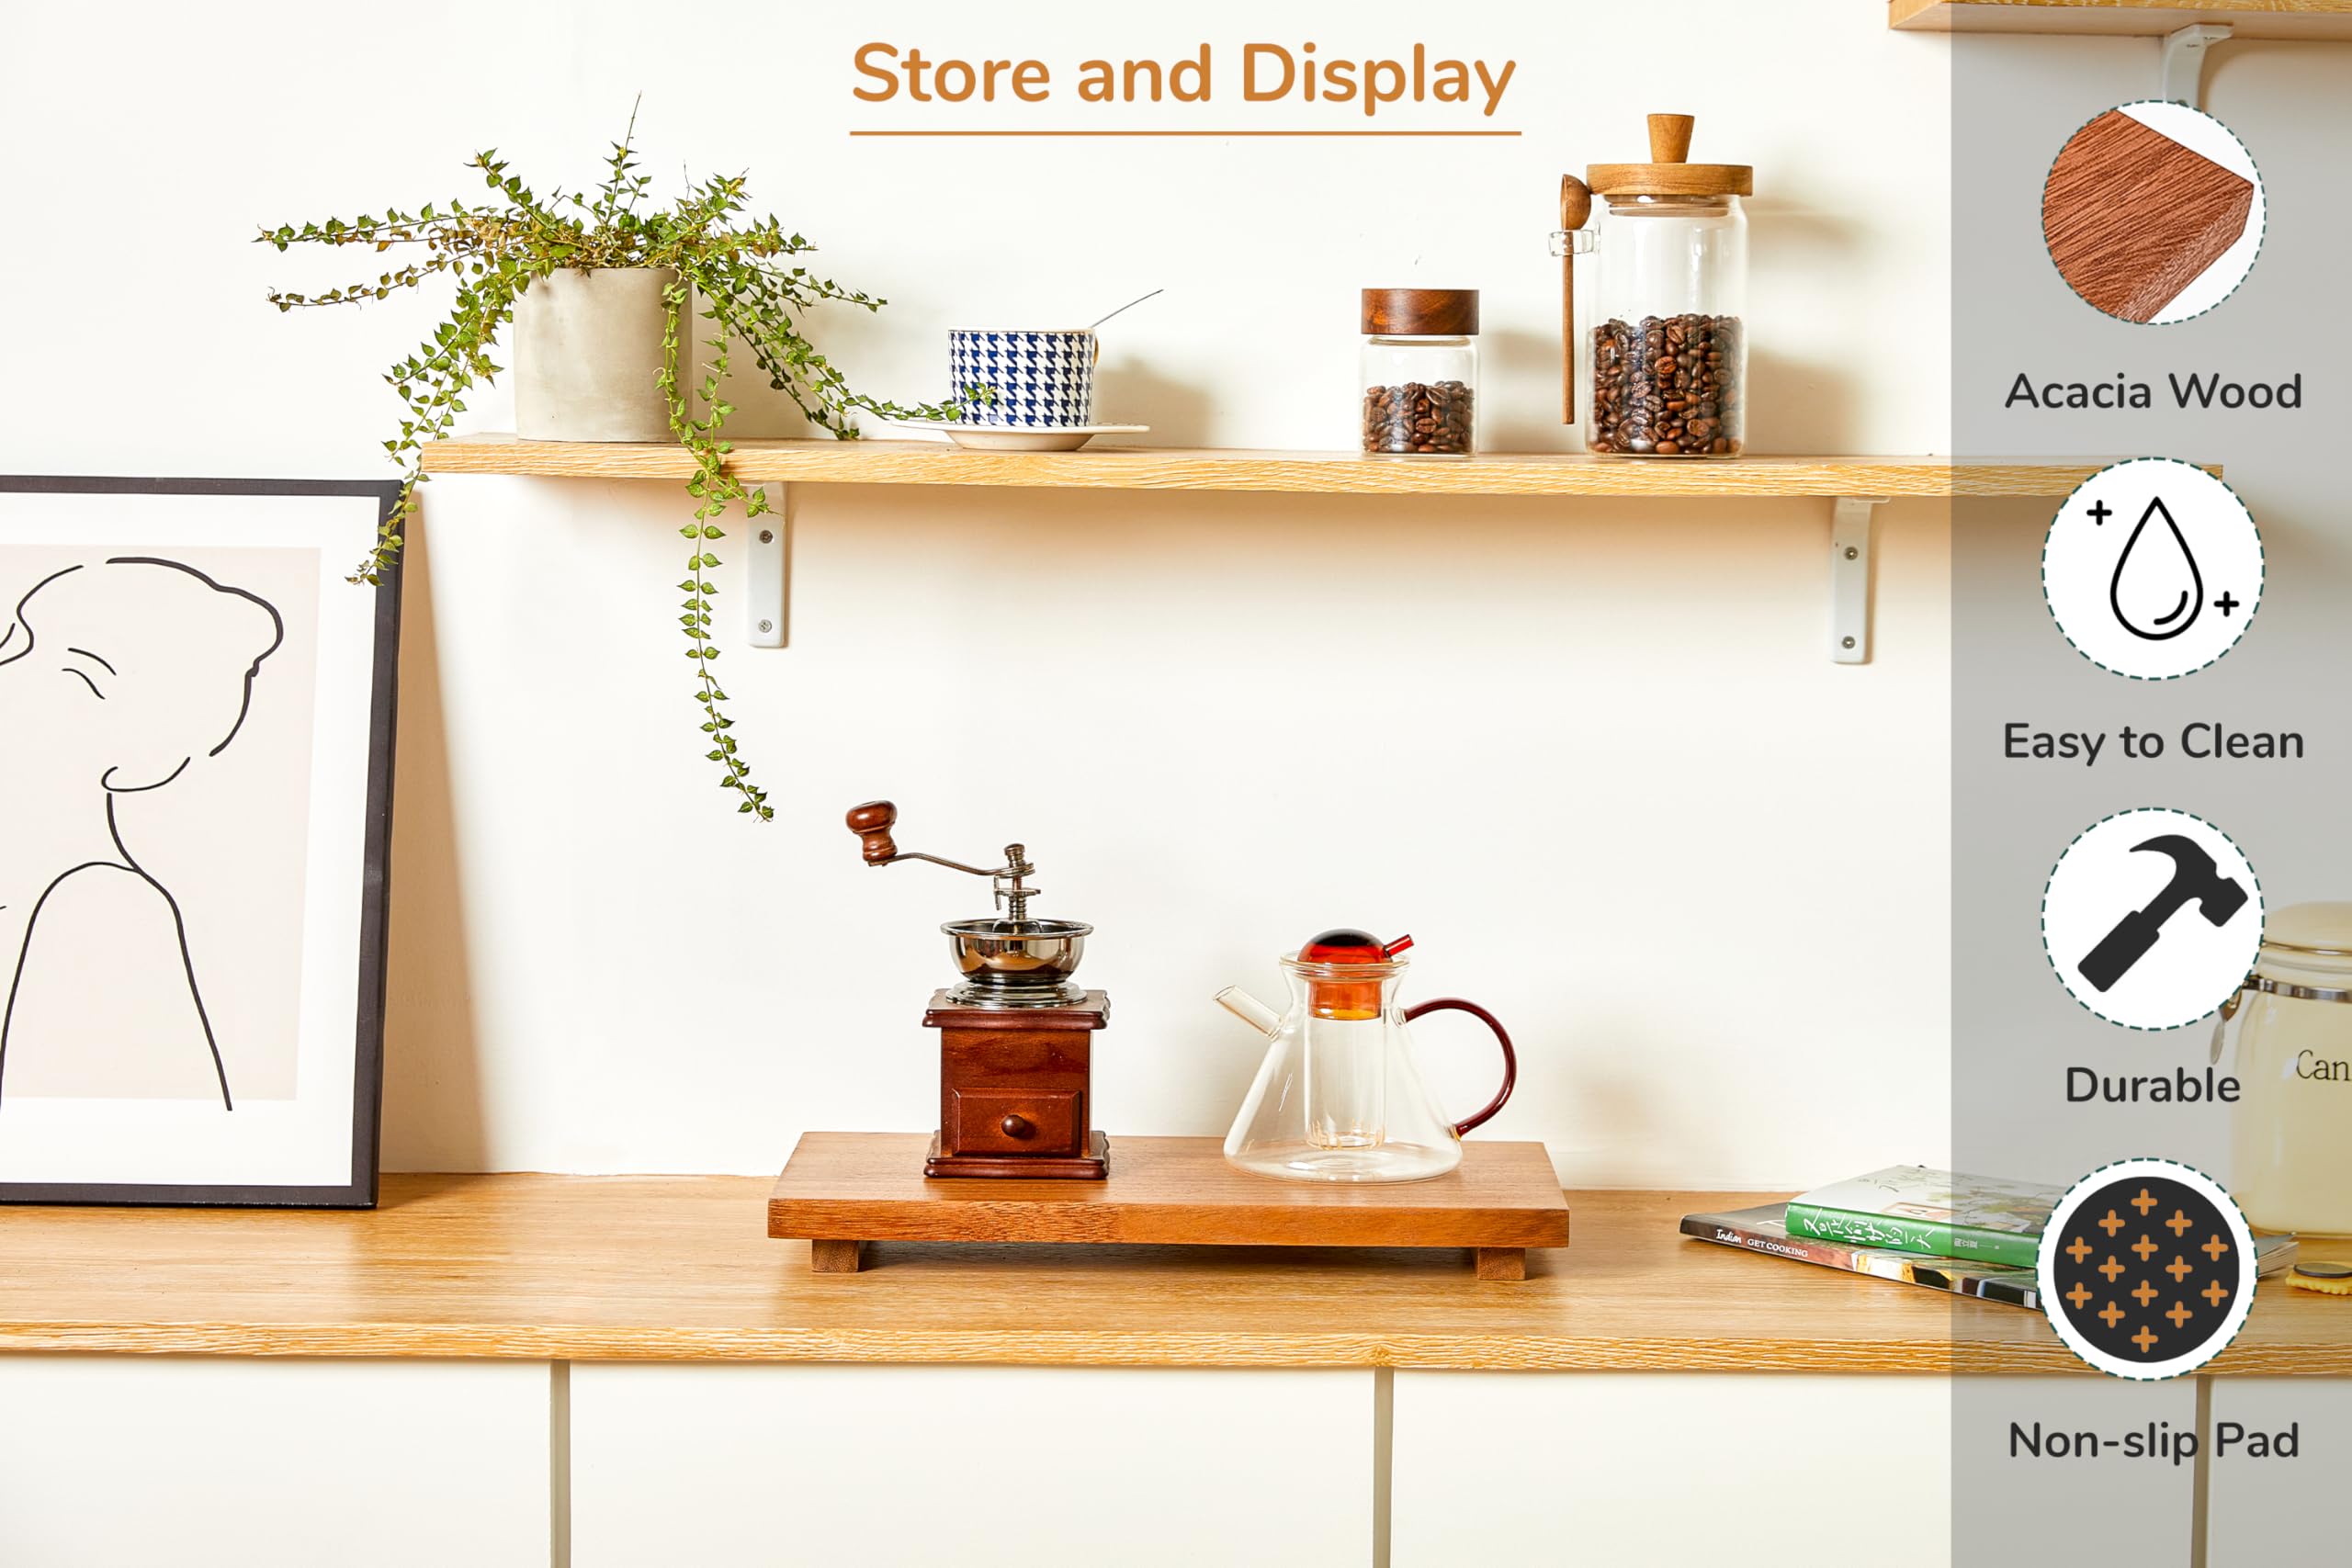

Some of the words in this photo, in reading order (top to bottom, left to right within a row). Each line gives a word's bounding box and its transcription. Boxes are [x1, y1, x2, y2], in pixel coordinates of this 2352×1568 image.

[1715, 1228, 1742, 1244] Indian
[1747, 1238, 1767, 1248] GET
[1766, 1242, 1809, 1258] COOKING
